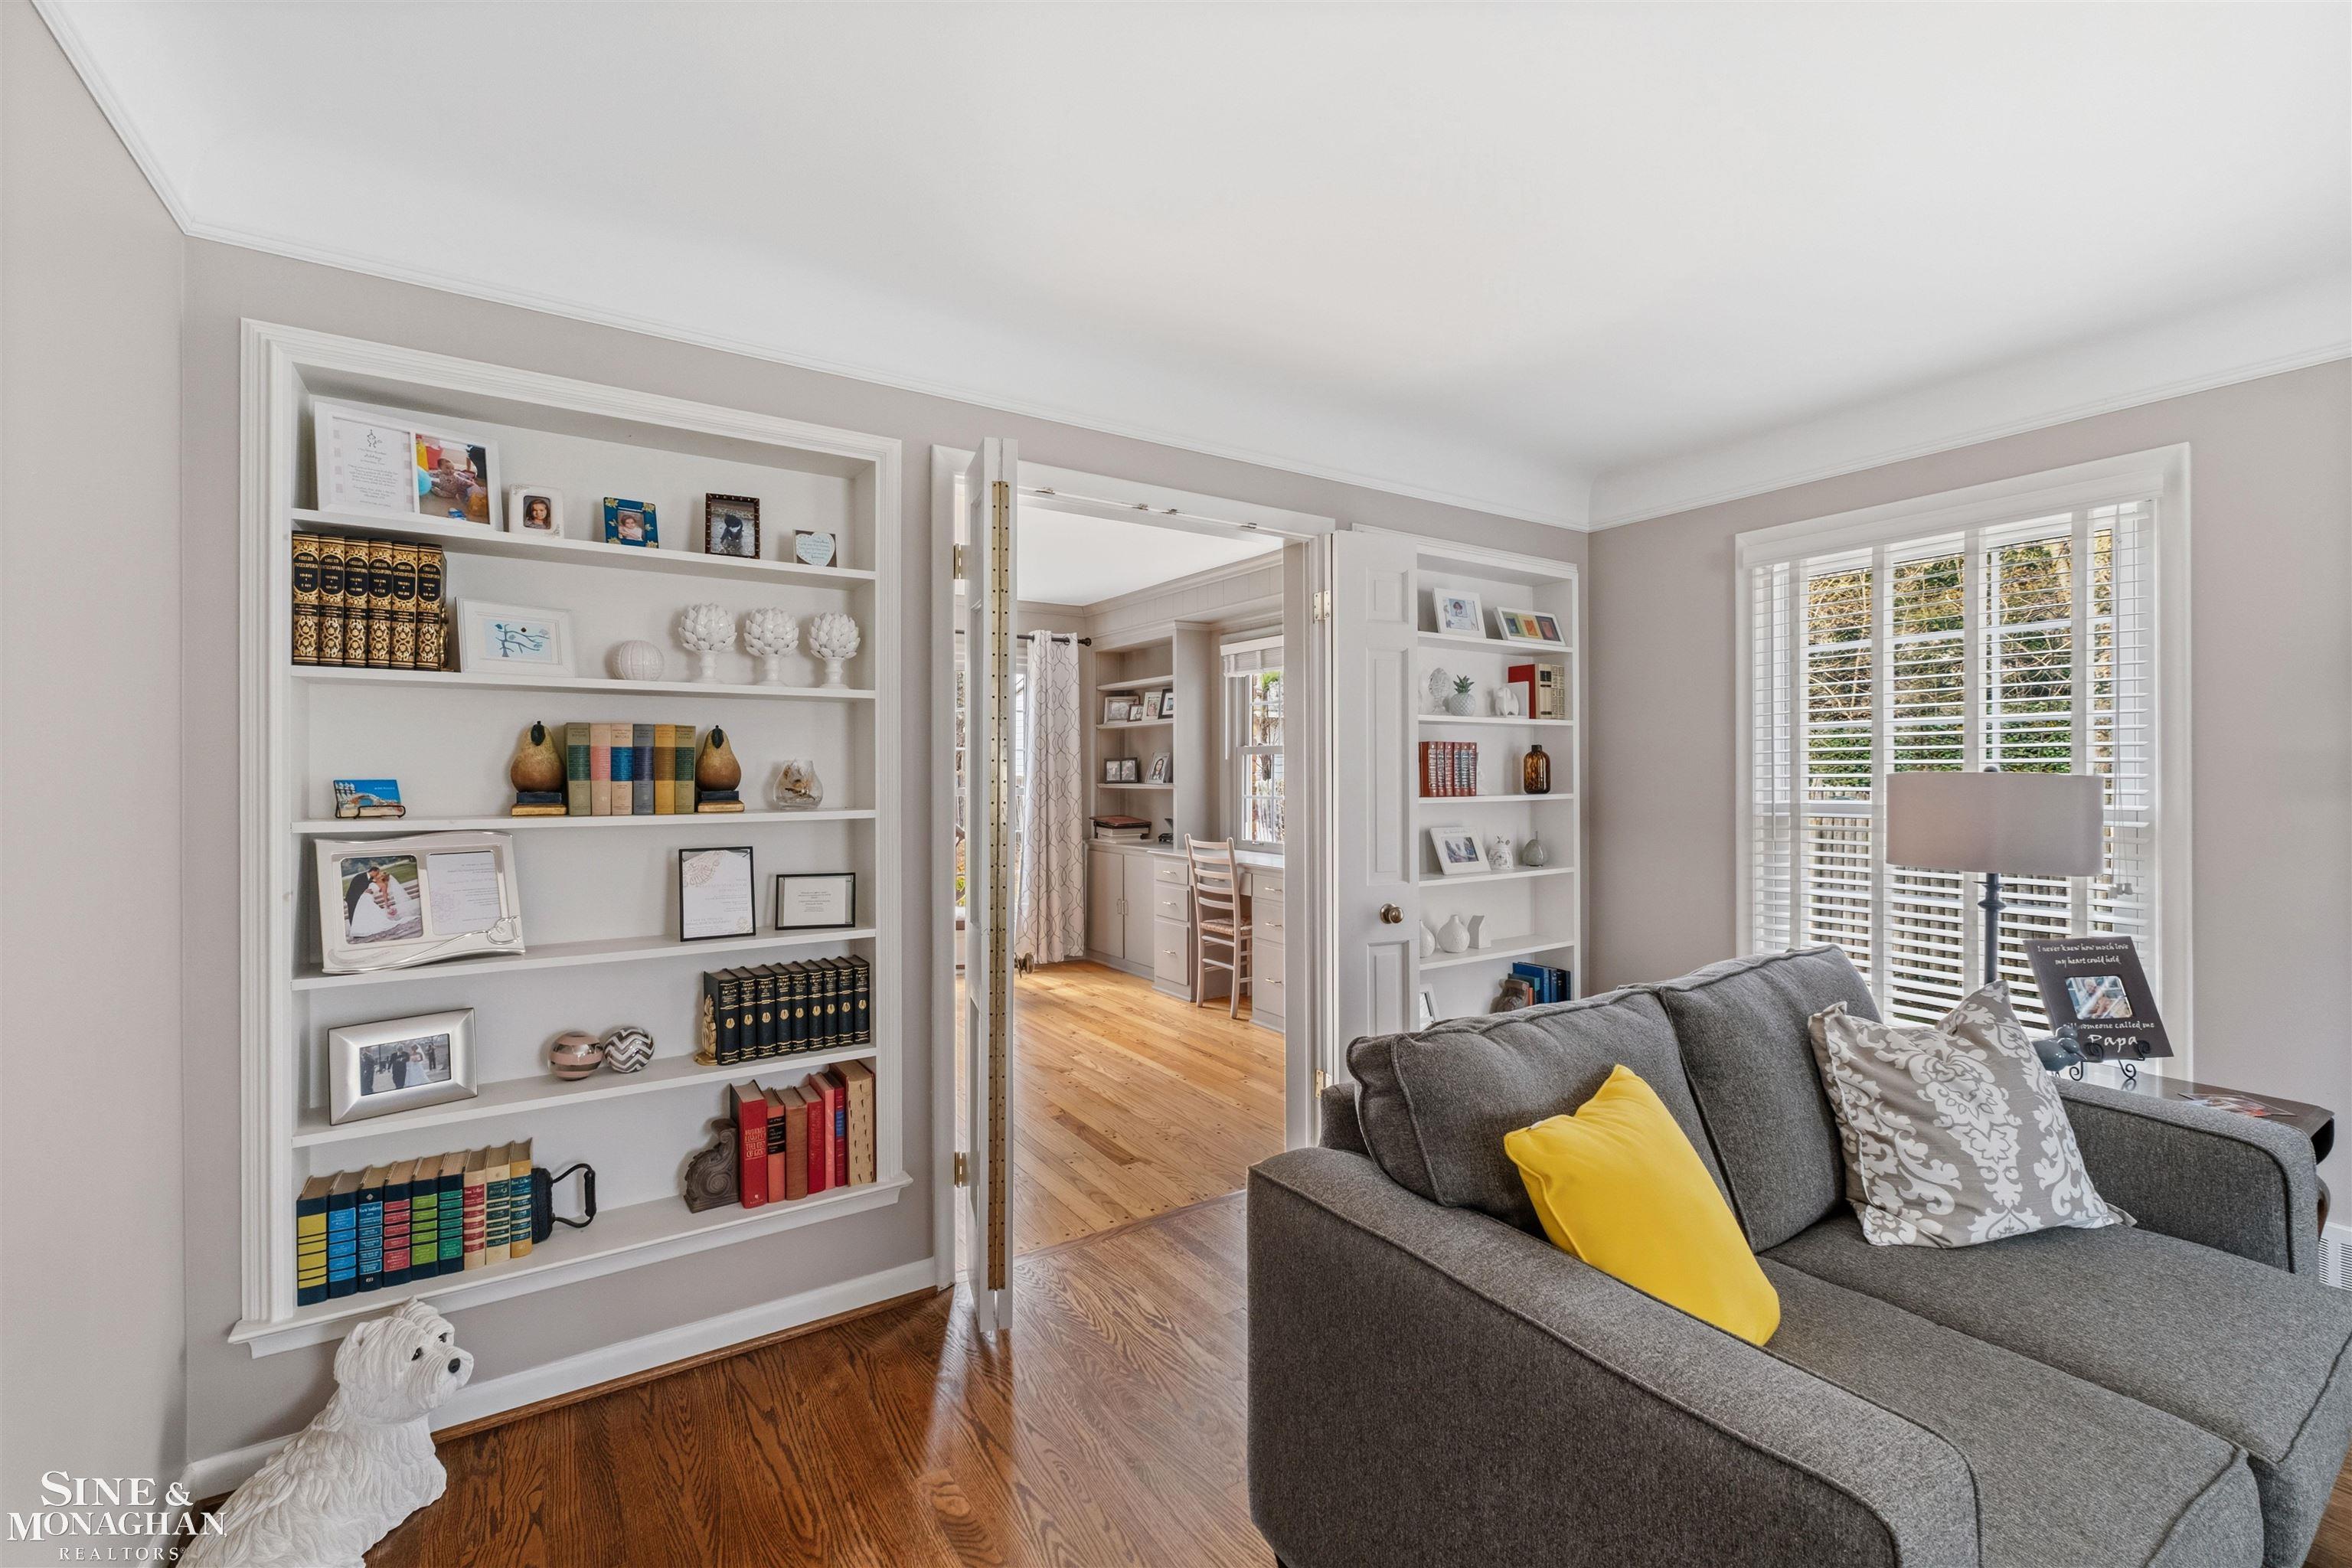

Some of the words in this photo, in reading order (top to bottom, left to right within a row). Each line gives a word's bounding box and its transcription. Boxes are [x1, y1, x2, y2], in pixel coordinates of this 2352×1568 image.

[2055, 959, 2066, 968] my
[2086, 956, 2106, 965] could
[2105, 955, 2122, 965] hold
[2115, 1021, 2142, 1030] called
[2087, 1034, 2138, 1053] Papa
